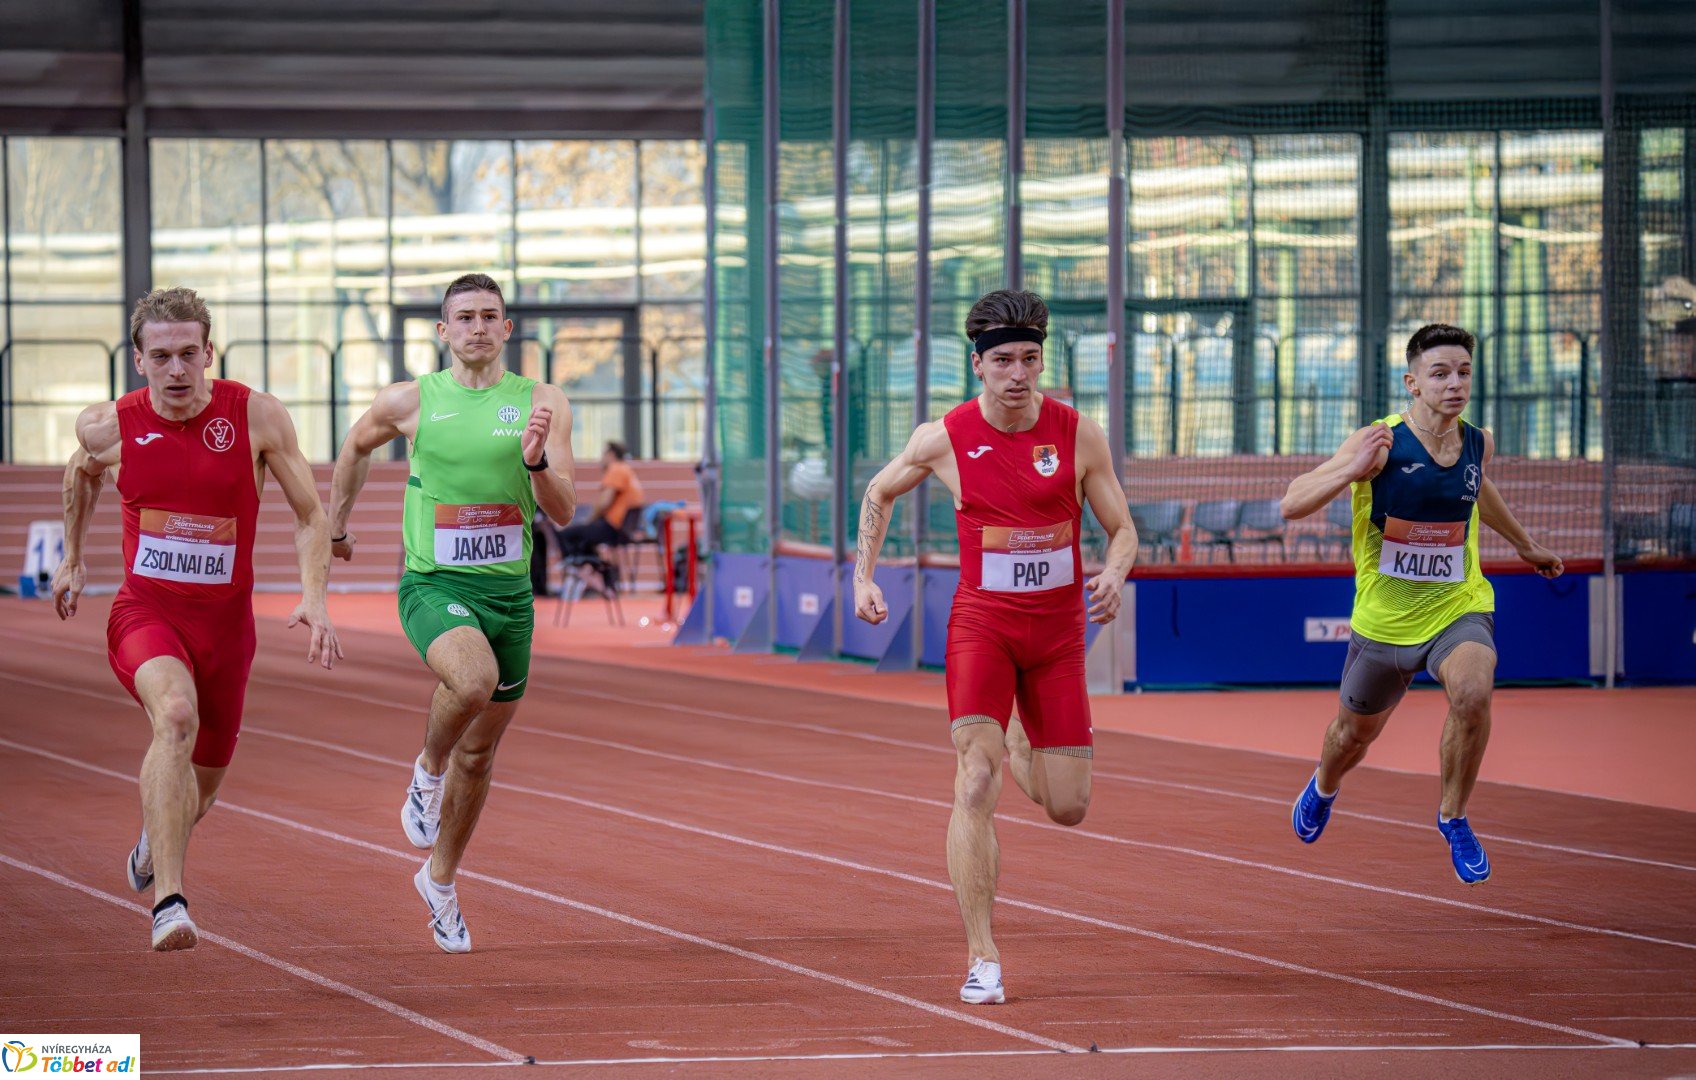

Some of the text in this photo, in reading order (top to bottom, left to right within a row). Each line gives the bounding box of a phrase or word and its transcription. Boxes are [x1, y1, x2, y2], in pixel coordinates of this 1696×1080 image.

[140, 547, 227, 575] ZSOLNAI BÁ.
[452, 534, 506, 561] JAKAB
[1013, 561, 1050, 587] PAP
[1393, 550, 1453, 577] KALICS
